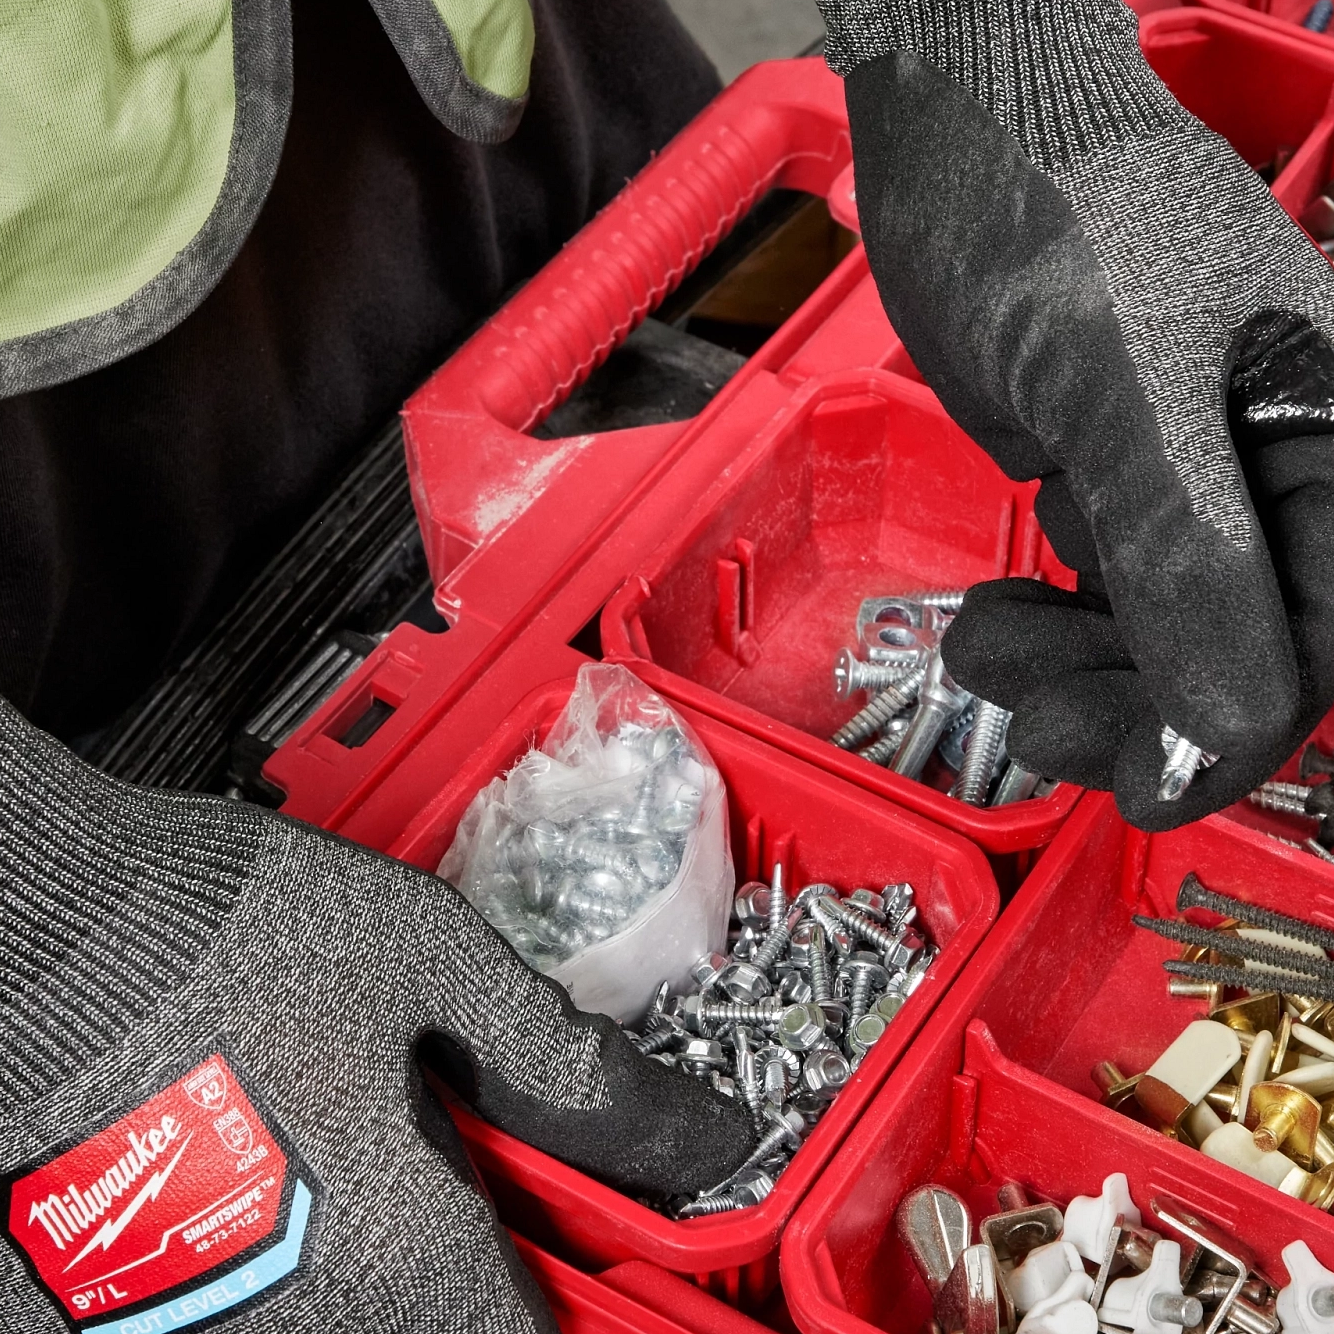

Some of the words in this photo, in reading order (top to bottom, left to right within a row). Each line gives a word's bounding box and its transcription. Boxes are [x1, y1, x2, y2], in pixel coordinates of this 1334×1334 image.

[201, 1081, 224, 1104] A2
[213, 1107, 241, 1132] EN388
[236, 1144, 269, 1172] 4243B
[28, 1115, 182, 1250] Milwaukee
[195, 1209, 262, 1253] 48-73-7122
[167, 1284, 240, 1323] LEVEL
[241, 1270, 260, 1289] 2
